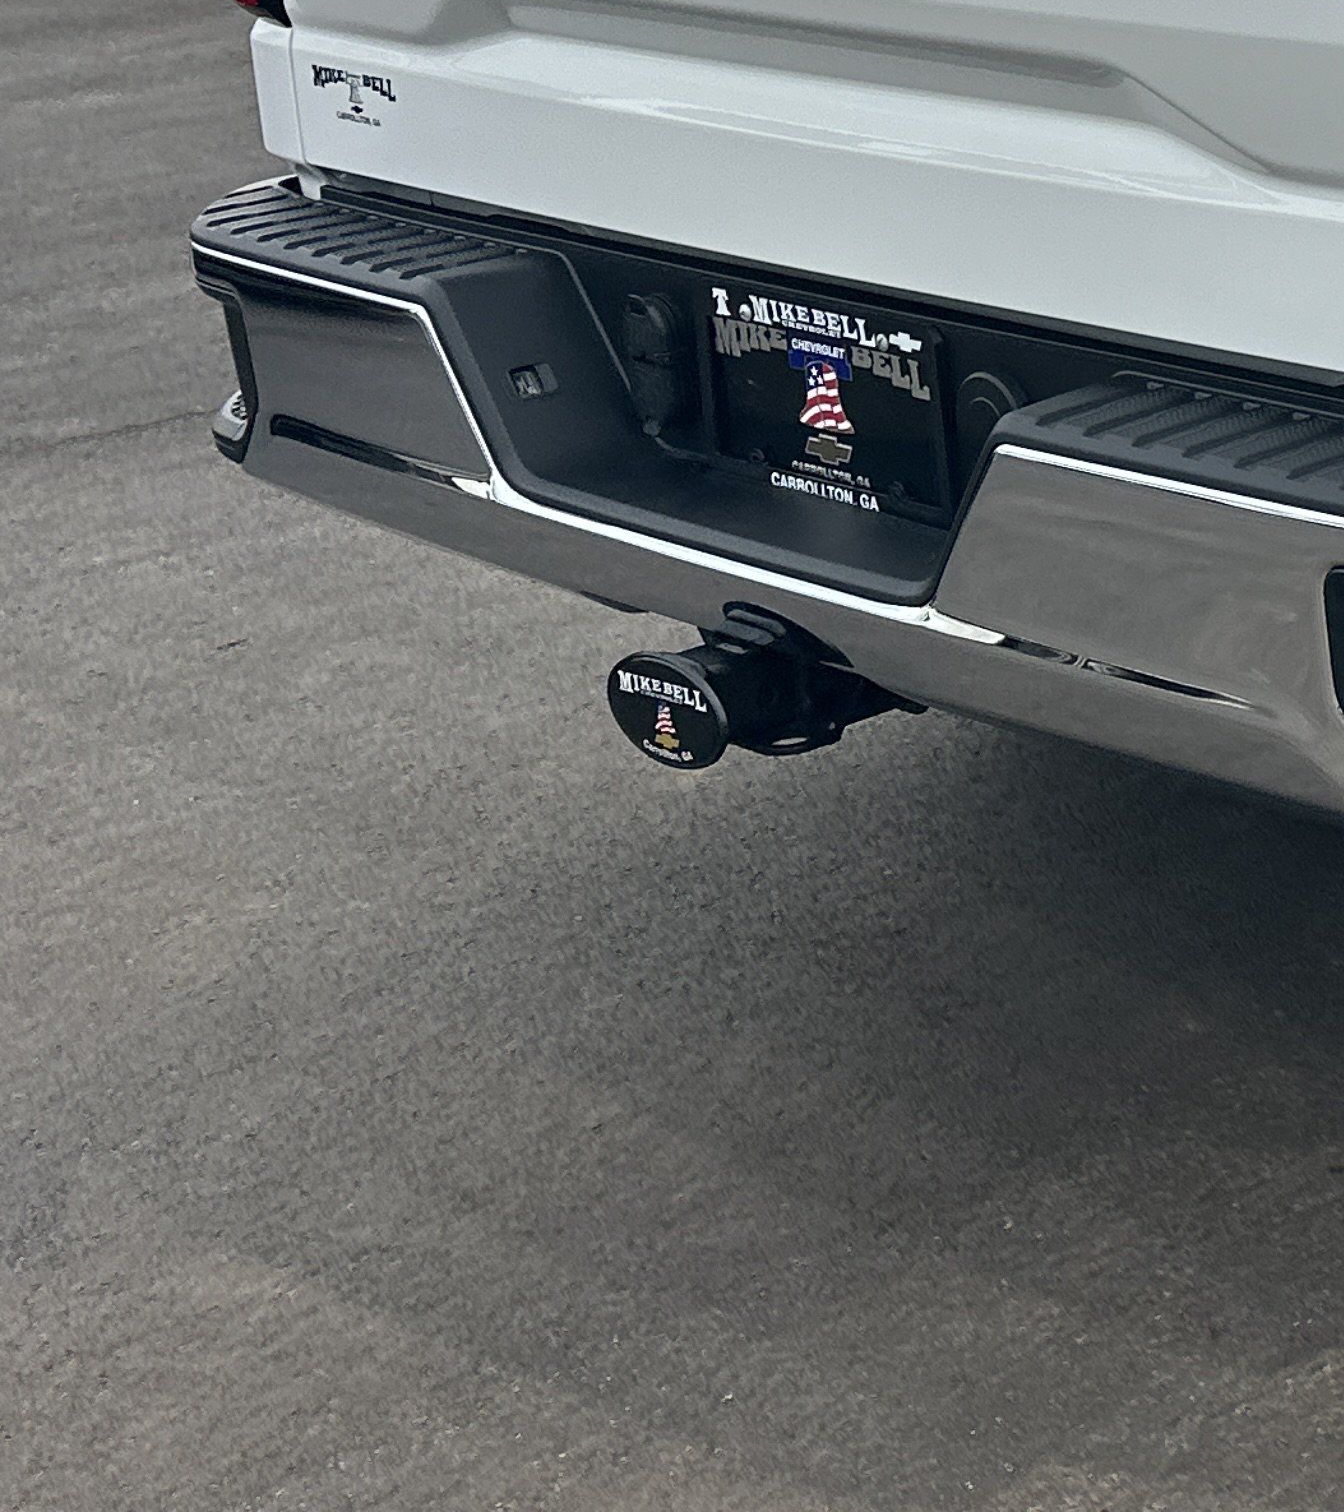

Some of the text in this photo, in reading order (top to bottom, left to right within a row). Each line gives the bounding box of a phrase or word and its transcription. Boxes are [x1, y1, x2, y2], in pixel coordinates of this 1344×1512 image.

[311, 64, 397, 102] MIKE BELL
[748, 294, 876, 348] MIKE BELL
[712, 316, 931, 401] MIKE BELL
[791, 338, 846, 360] CHEVROLET
[859, 493, 880, 513] GA
[617, 669, 662, 694] MIKE
[662, 681, 708, 712] BELL
